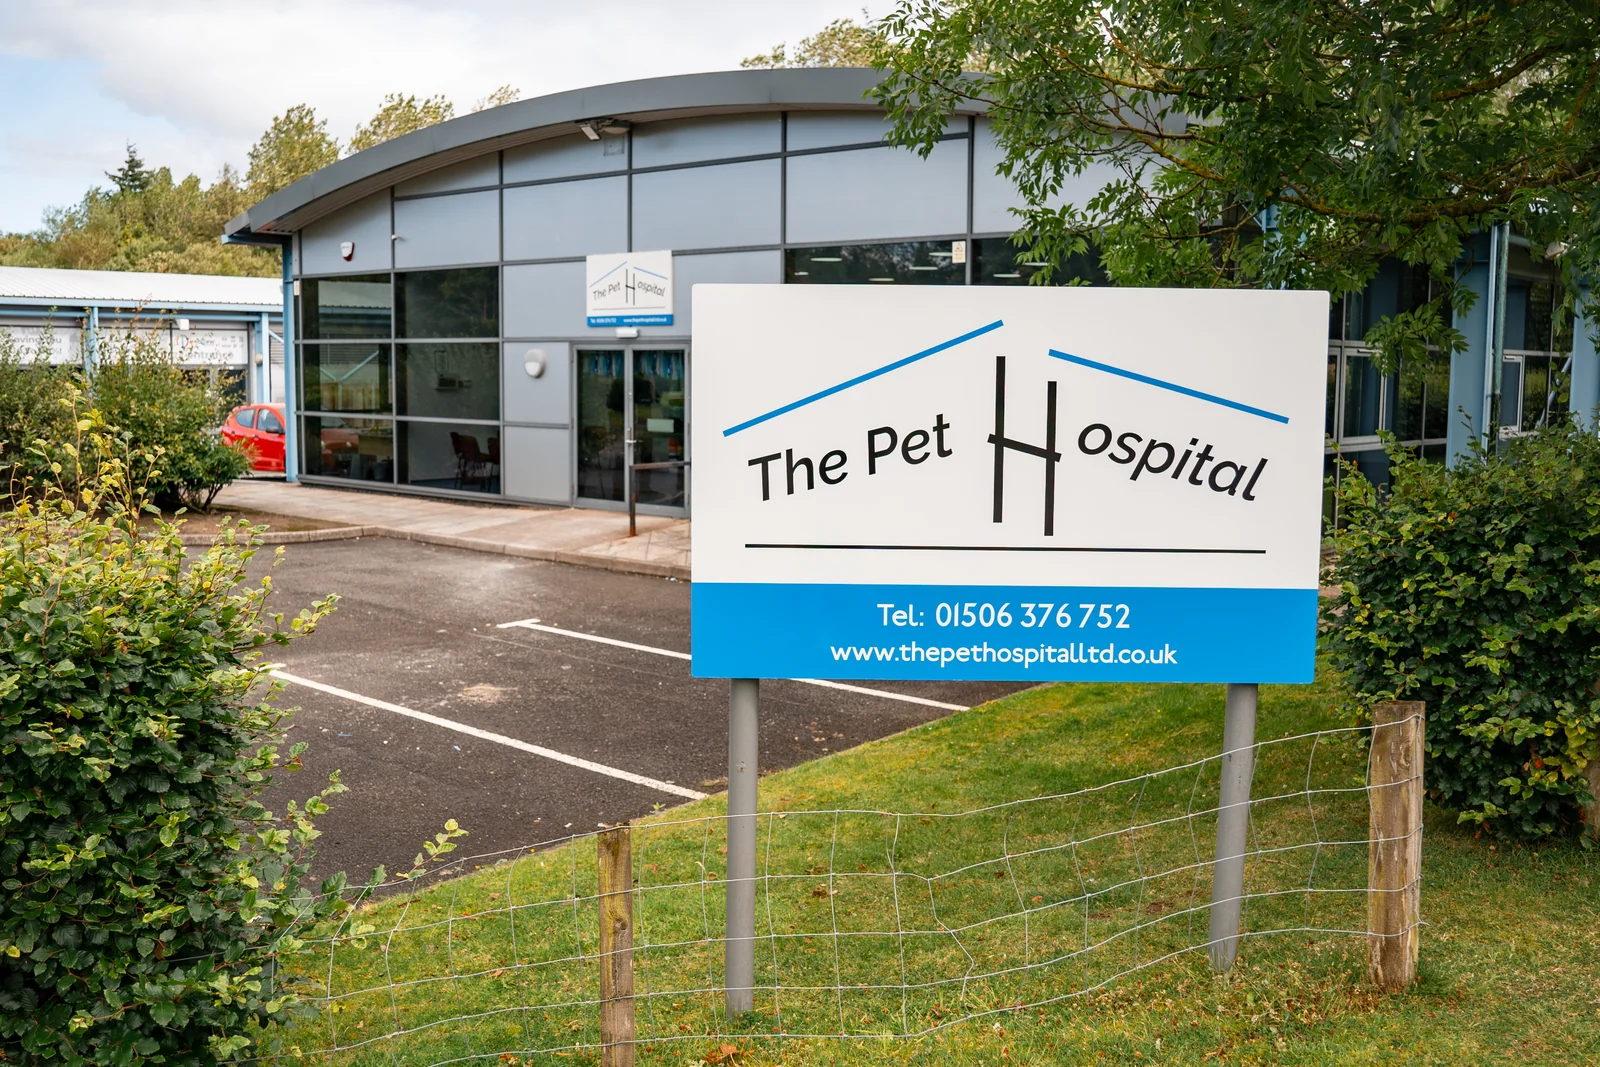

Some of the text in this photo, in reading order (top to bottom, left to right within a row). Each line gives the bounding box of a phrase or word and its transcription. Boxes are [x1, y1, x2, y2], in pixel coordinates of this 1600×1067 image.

[593, 268, 666, 306] The Pet Hospital
[747, 355, 1268, 537] The Pet Hospital
[877, 602, 1132, 629] Tel: 01506 376 752
[830, 640, 1178, 669] www.thepethospitalltd.co.uk
